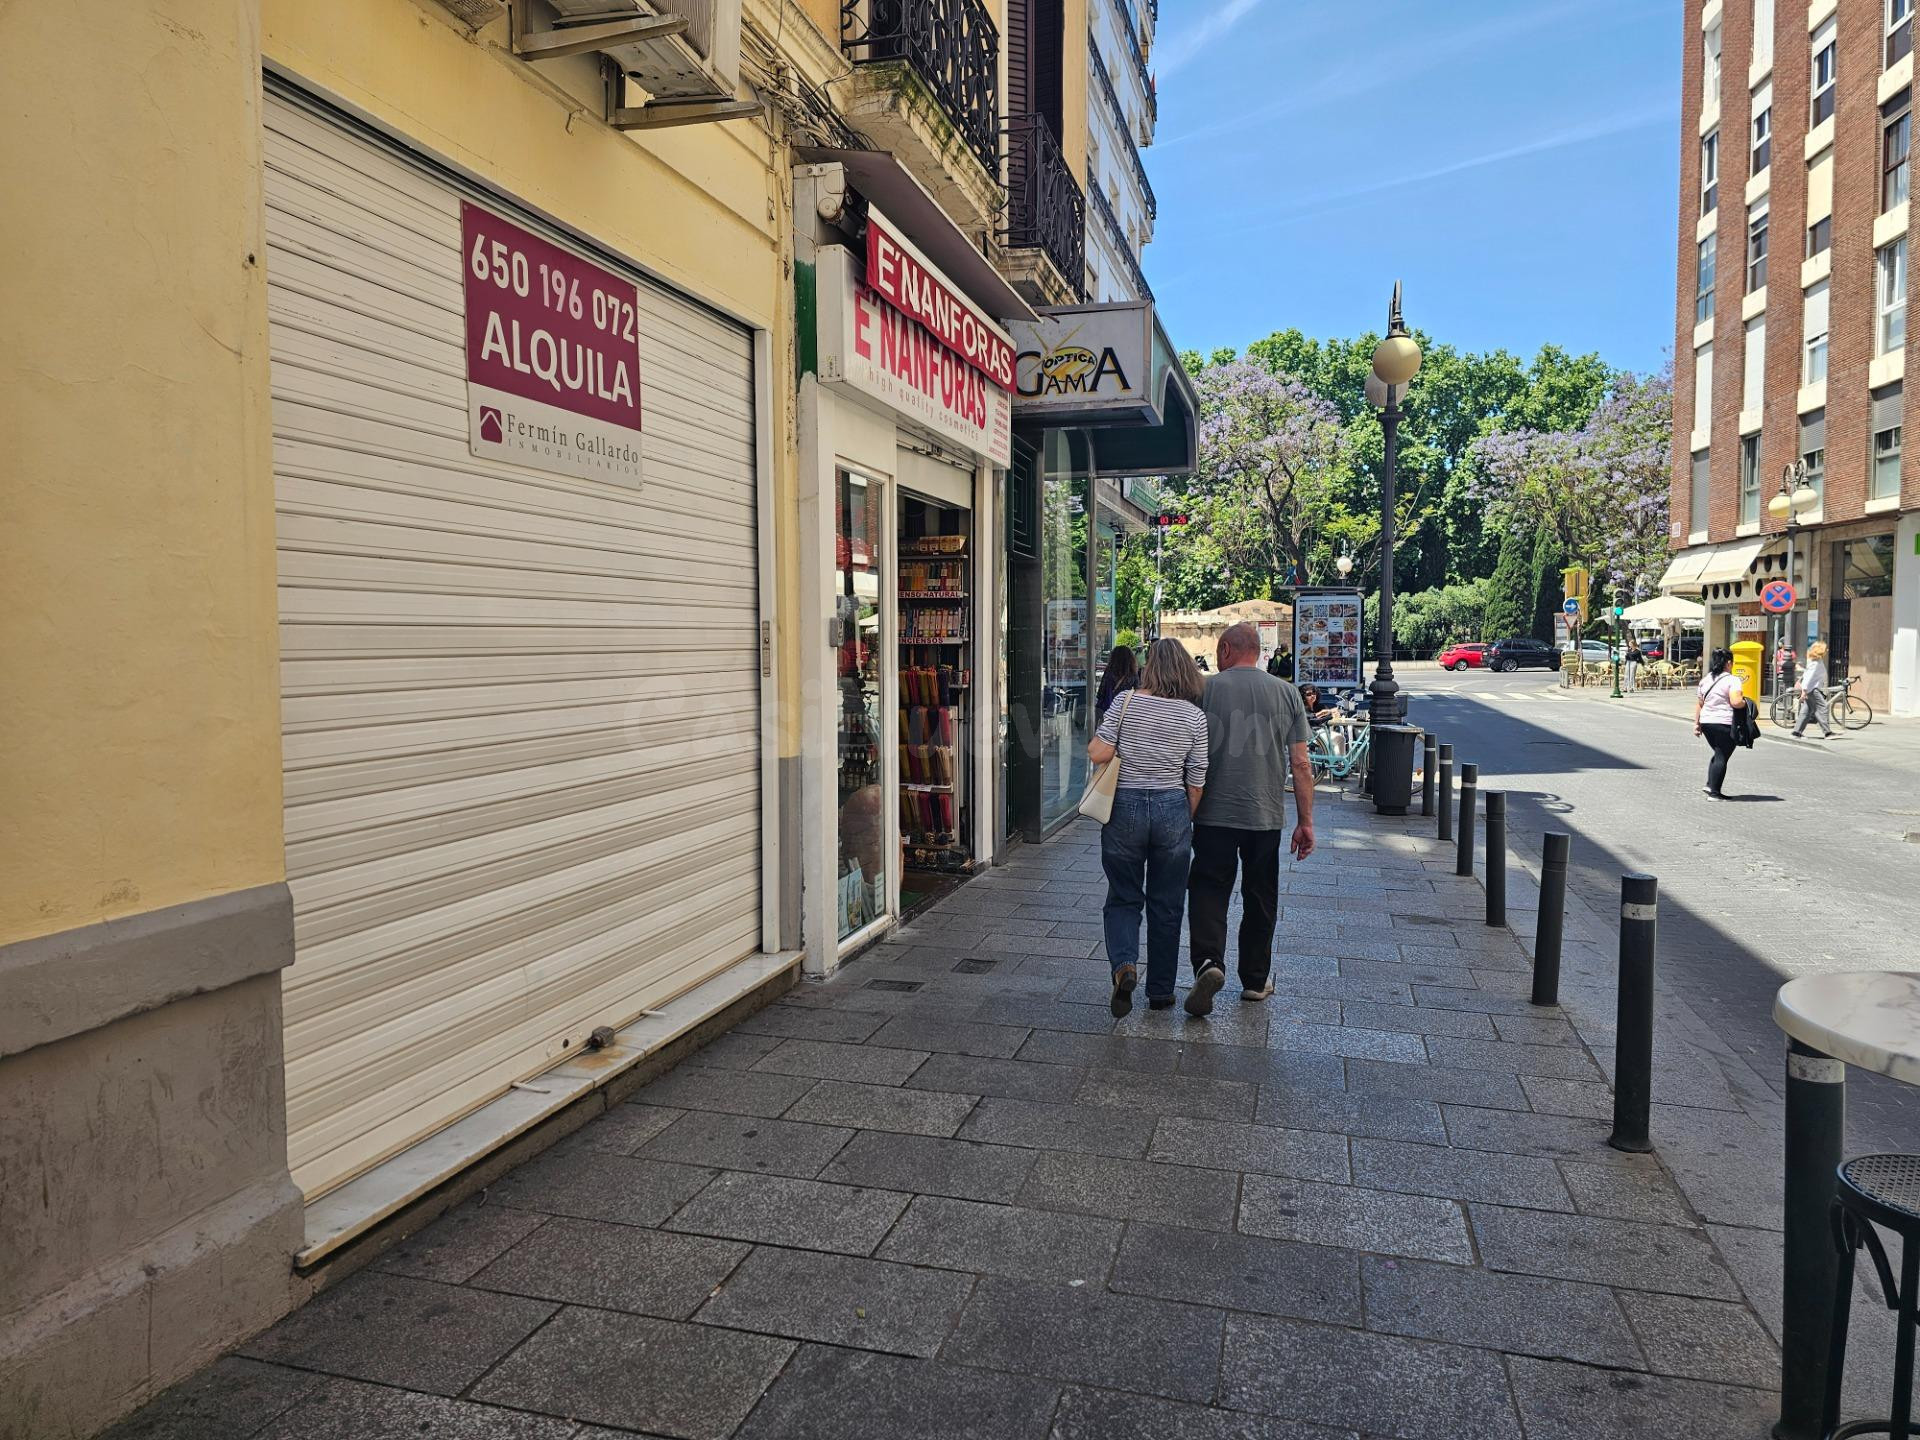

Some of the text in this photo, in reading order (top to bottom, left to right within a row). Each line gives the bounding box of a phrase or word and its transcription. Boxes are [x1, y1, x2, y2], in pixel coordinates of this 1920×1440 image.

[471, 233, 636, 344] 650 196 072
[481, 310, 634, 408] ALQUILA
[869, 366, 893, 393] high
[1016, 346, 1132, 398] GAMA
[507, 412, 638, 464] Fermín Gallardo
